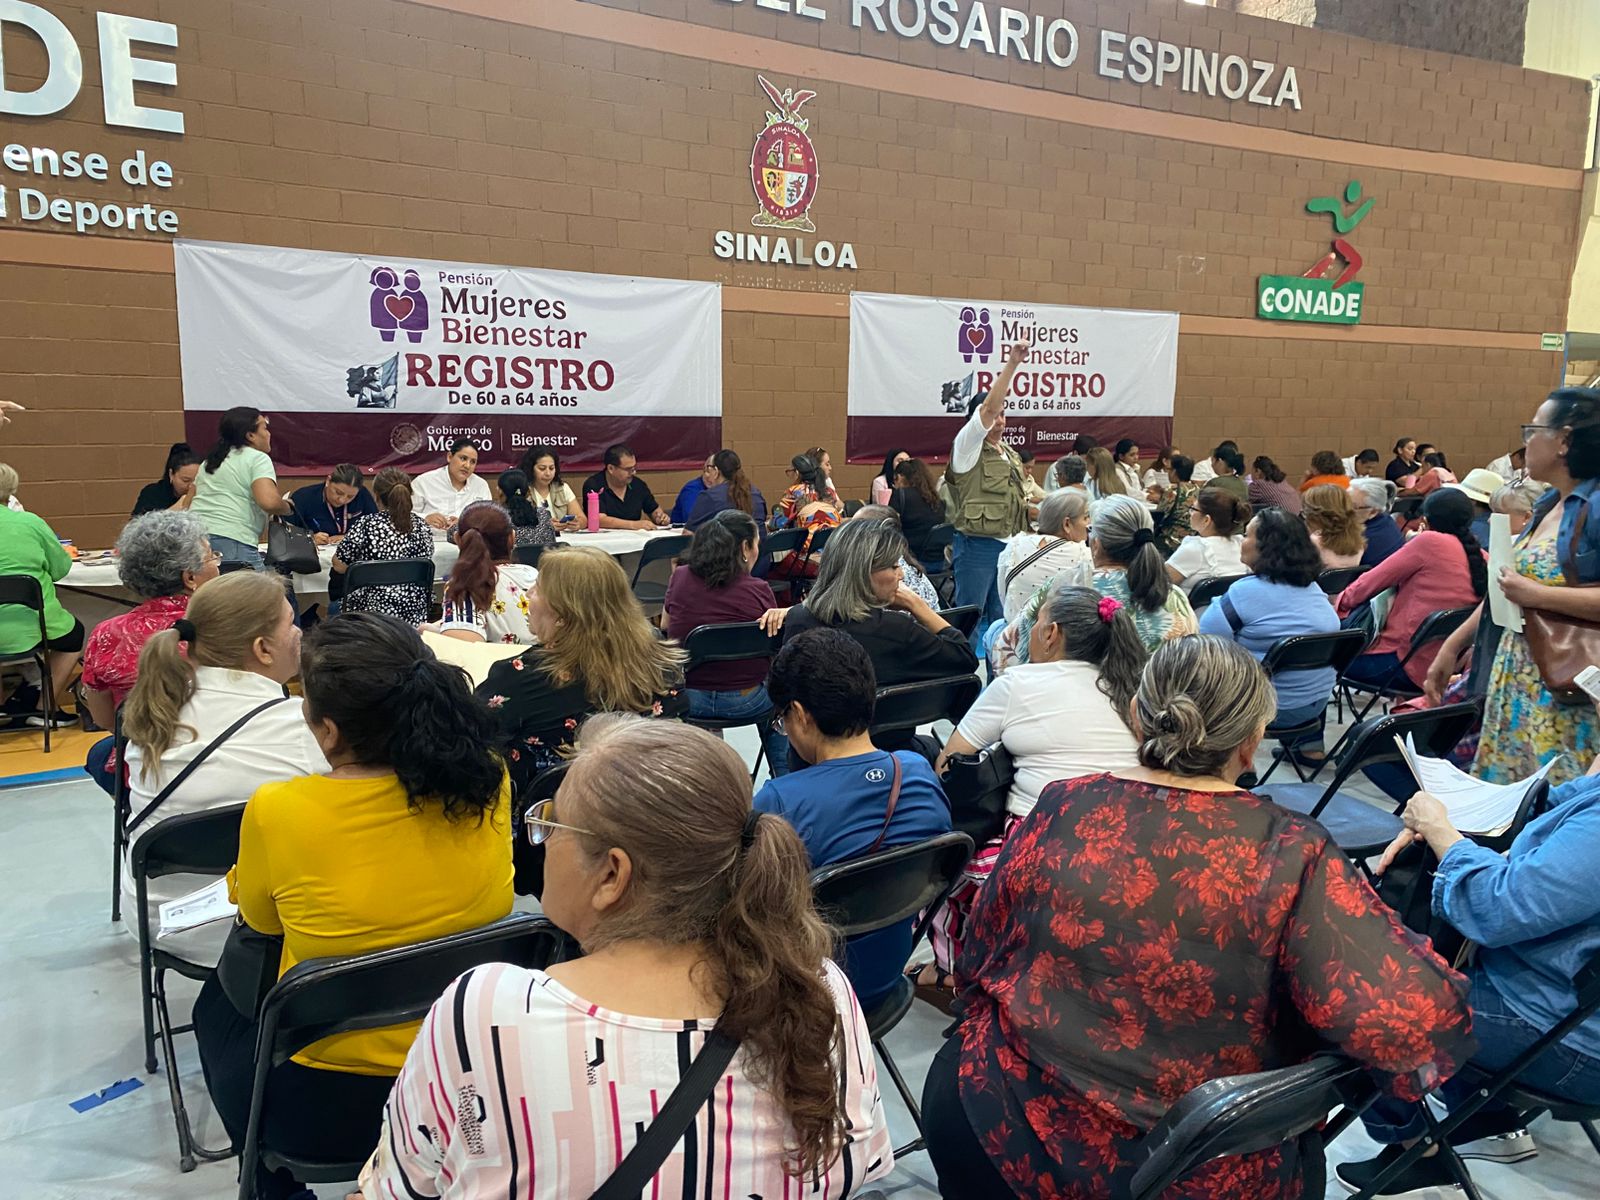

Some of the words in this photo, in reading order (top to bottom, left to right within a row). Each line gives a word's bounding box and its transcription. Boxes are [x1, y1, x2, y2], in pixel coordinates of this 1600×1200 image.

[852, 0, 1079, 68] ROSARIO
[1100, 29, 1301, 110] ESPINOZA
[771, 126, 800, 138] SINALOA
[121, 150, 173, 188] de
[19, 188, 178, 233] Deporte
[714, 231, 857, 268] SINALOA
[438, 271, 493, 286] Pensión
[441, 286, 567, 323] Mujeres
[1001, 308, 1035, 319] Pensión
[1261, 287, 1360, 317] CONADE
[441, 317, 587, 349] Bienestar
[1001, 320, 1079, 347] Mujeres
[1000, 343, 1090, 365] Bnestar
[405, 353, 615, 392] REGISTRO
[977, 371, 1106, 398] RGISTRO
[448, 390, 472, 406] De
[476, 391, 496, 405] 60
[501, 395, 510, 406] a
[515, 393, 534, 406] 64
[539, 393, 578, 407] años
[1018, 400, 1030, 410] 60
[1033, 402, 1039, 410] a
[1042, 400, 1054, 410] 64
[1056, 399, 1081, 410] años
[426, 425, 477, 435] Gobierno
[480, 425, 492, 435] de
[511, 433, 578, 446] Bienestar
[1036, 430, 1079, 441] Bienestar
